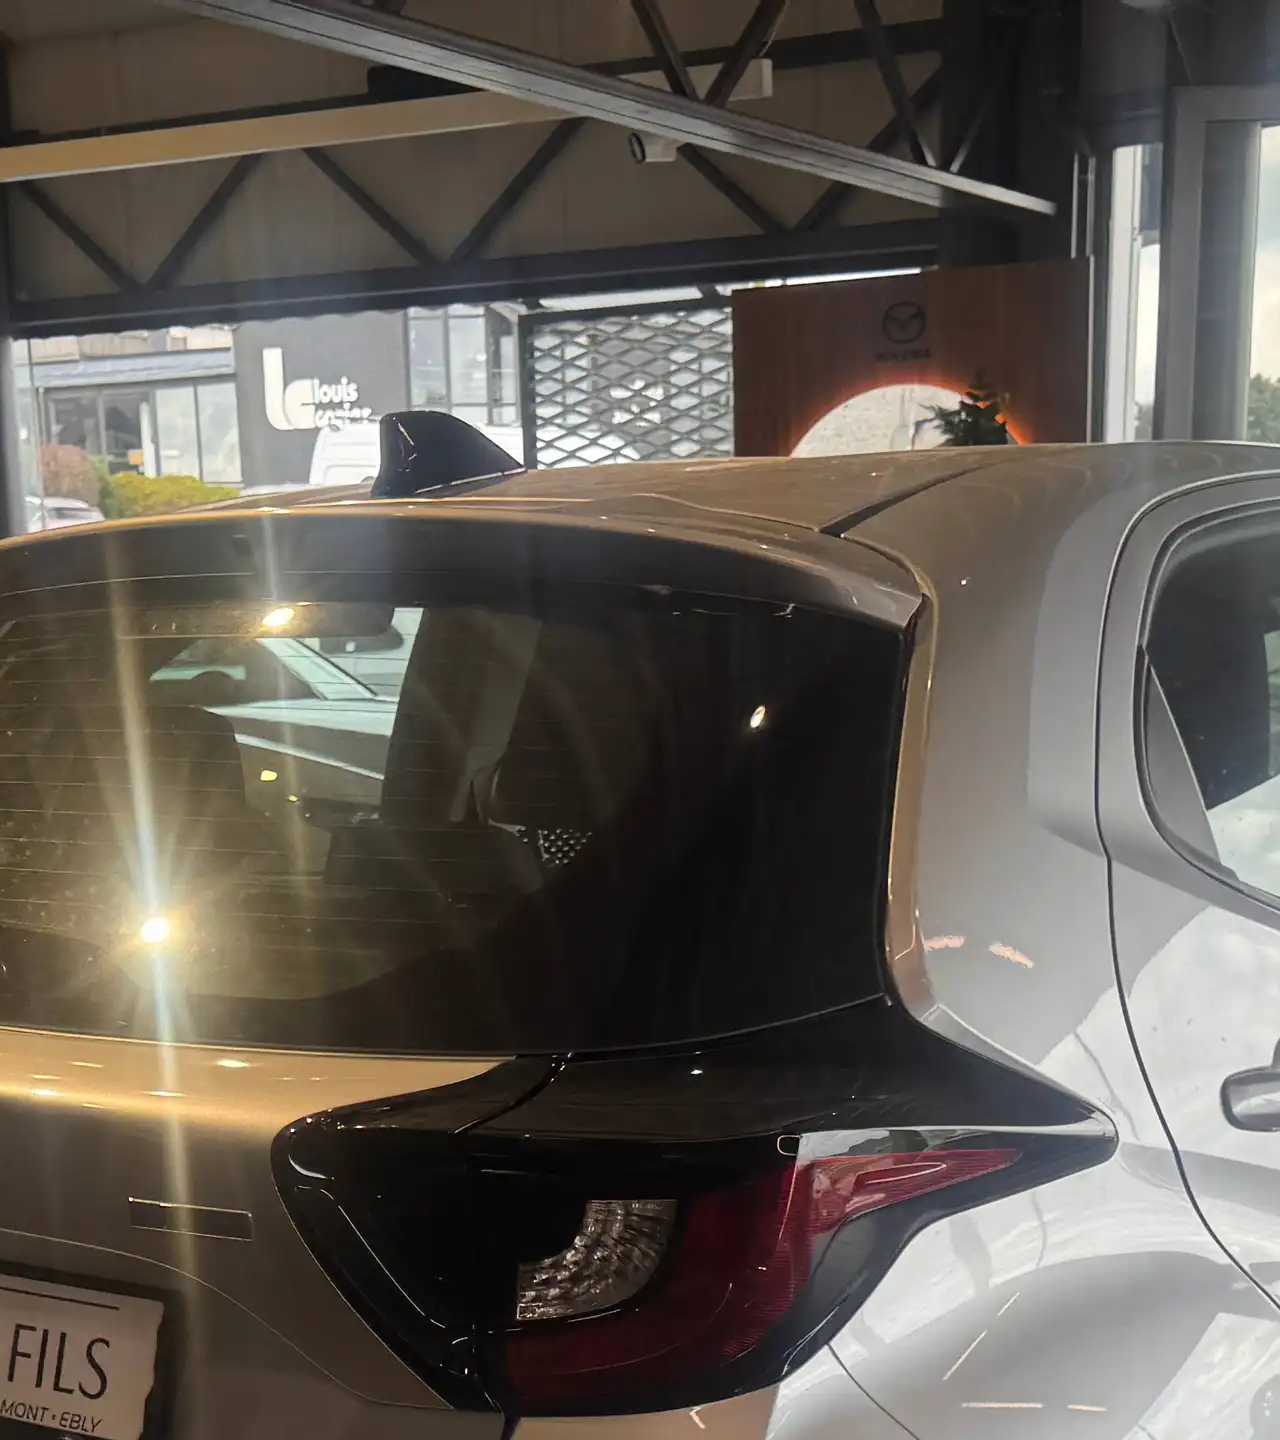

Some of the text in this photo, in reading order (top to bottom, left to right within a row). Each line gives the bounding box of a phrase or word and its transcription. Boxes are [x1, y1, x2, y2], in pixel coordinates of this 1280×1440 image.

[313, 376, 359, 404] louis
[7, 1322, 111, 1401] FILS
[58, 1411, 104, 1434] EBLY
